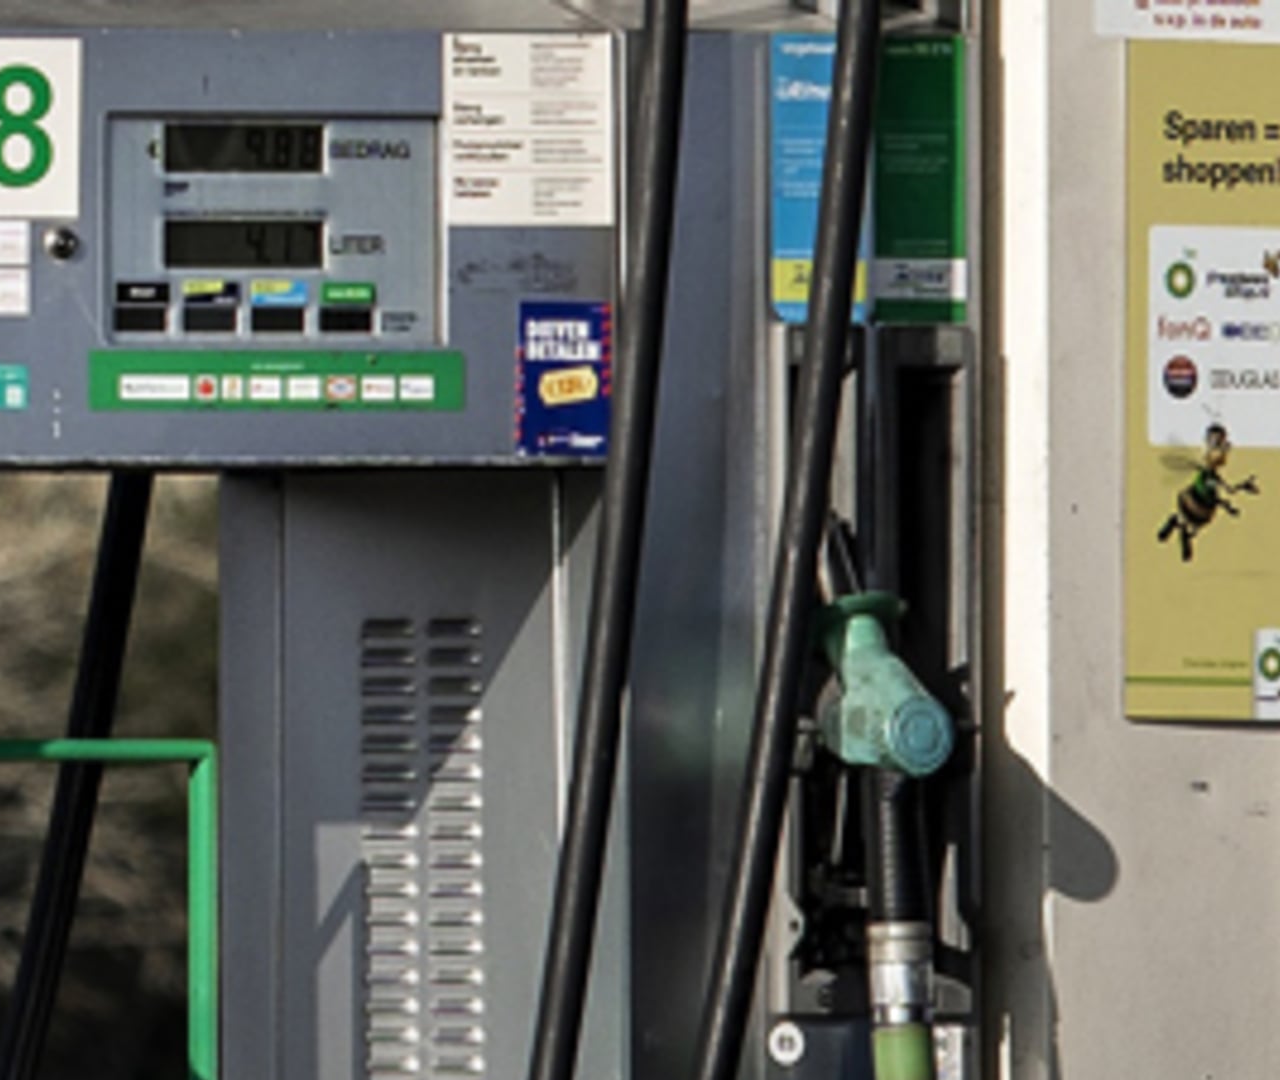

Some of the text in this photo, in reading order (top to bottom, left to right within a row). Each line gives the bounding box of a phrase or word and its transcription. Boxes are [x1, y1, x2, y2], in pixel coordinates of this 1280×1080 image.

[1163, 110, 1256, 146] Sparen
[330, 138, 411, 160] BEDRAG
[330, 235, 386, 255] LITER
